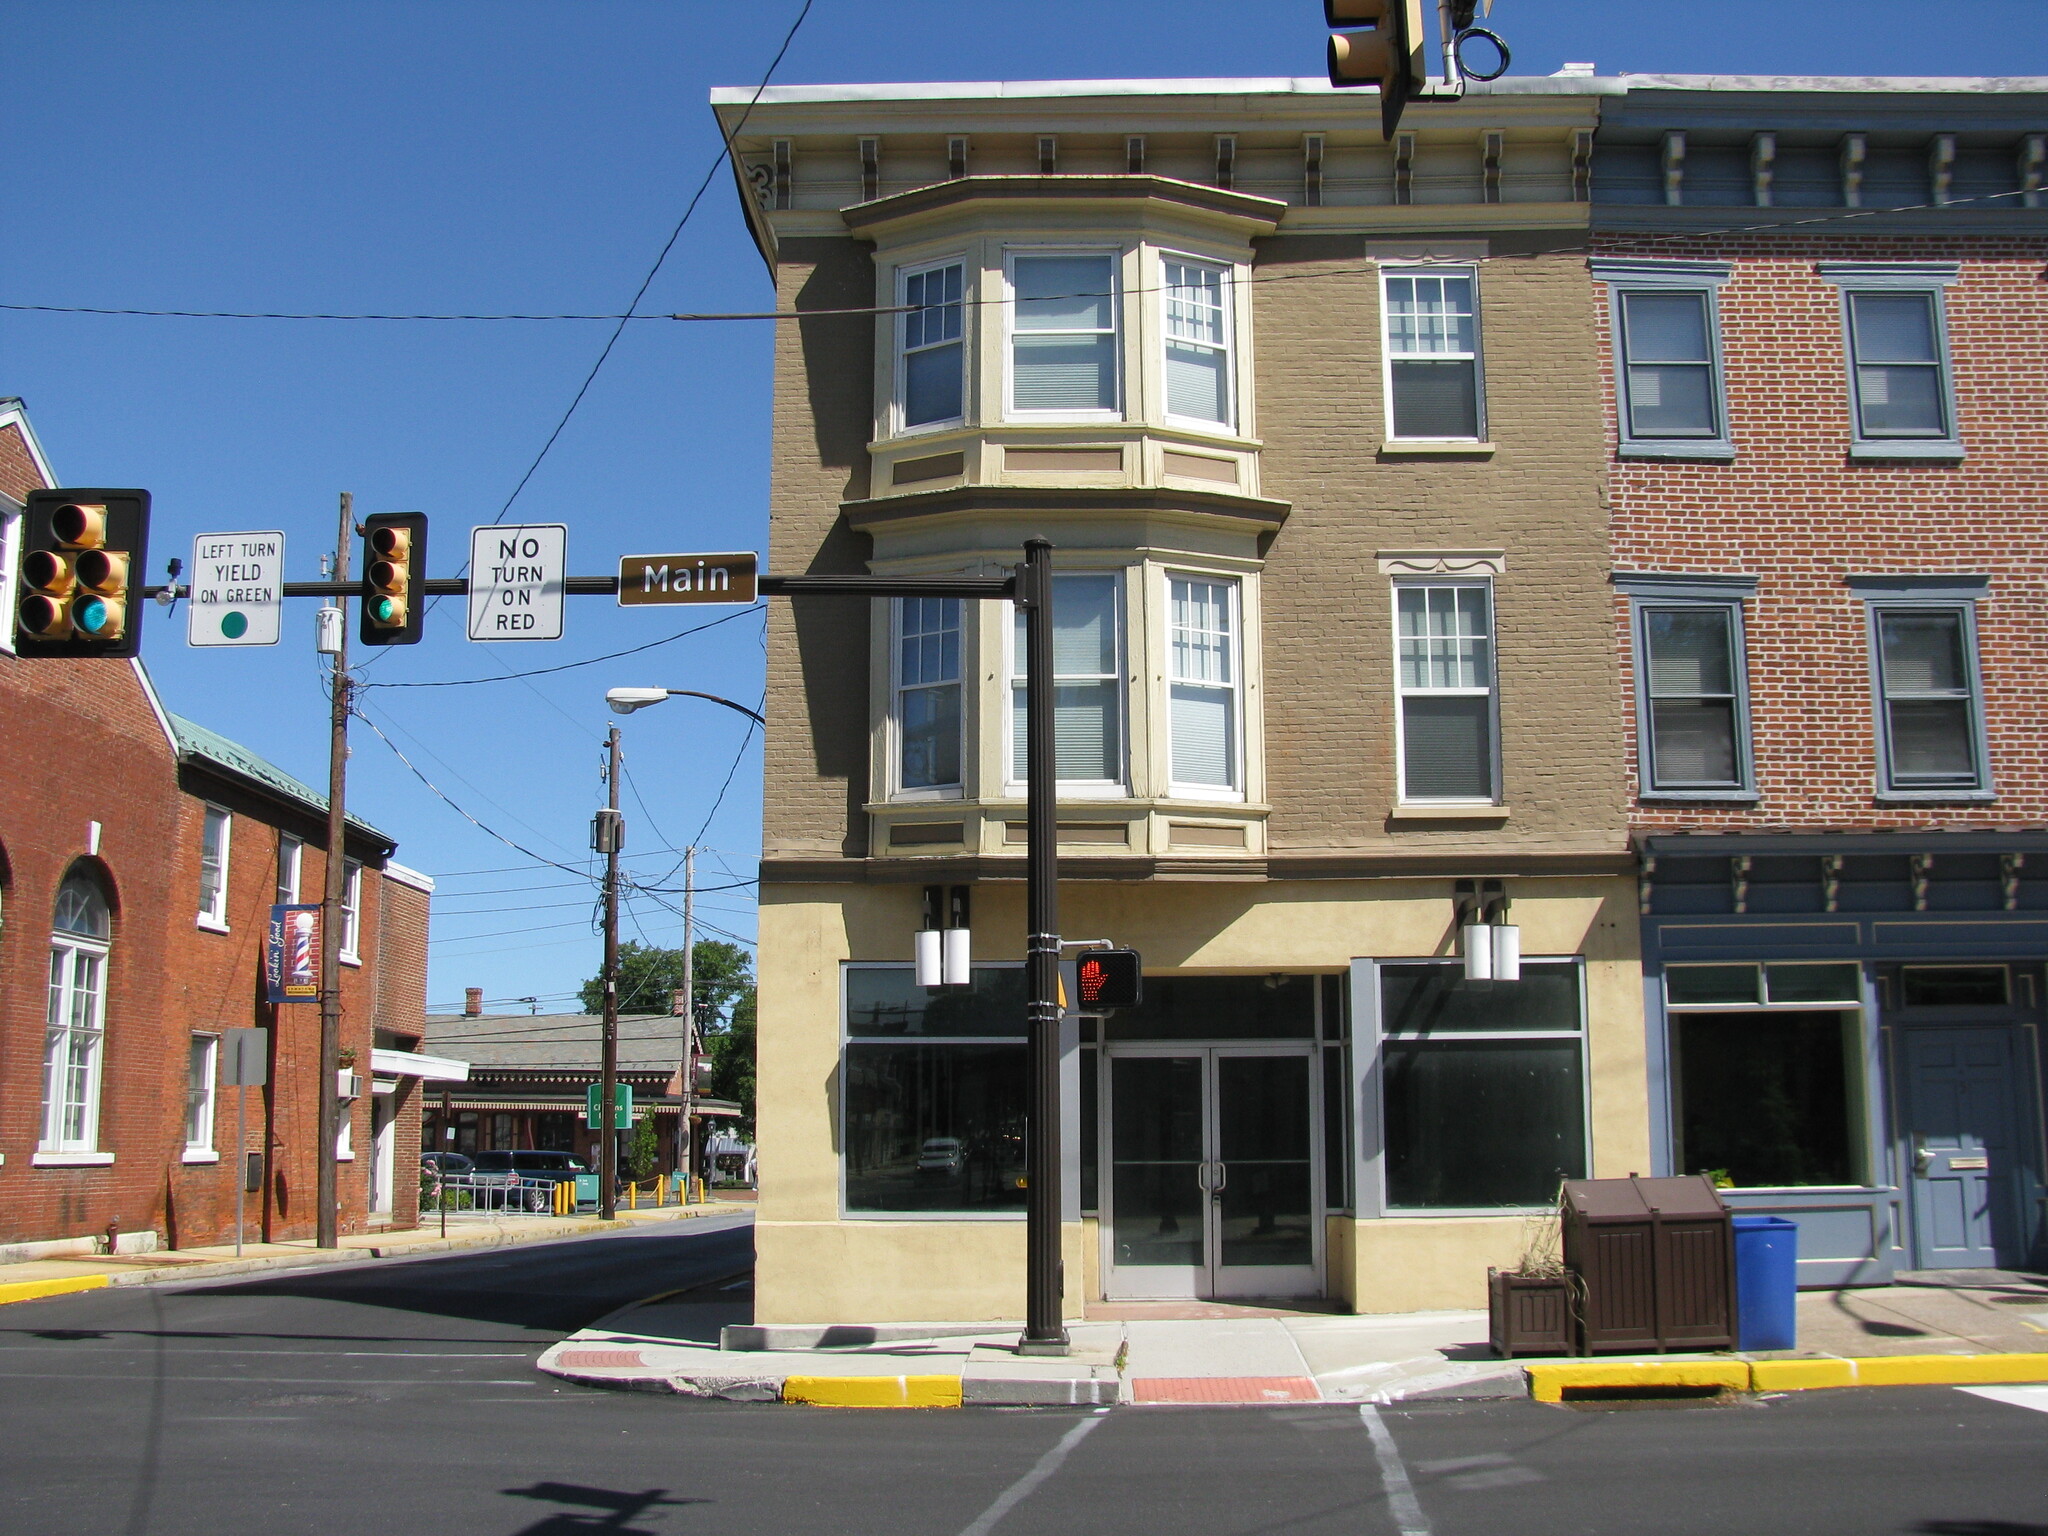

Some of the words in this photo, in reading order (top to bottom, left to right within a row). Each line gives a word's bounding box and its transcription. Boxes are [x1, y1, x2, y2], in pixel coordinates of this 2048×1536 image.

[202, 544, 234, 559] LEFT
[241, 543, 275, 557] TURN
[499, 538, 540, 559] NO
[215, 564, 261, 581] YIELD
[491, 566, 543, 583] TURN
[644, 560, 729, 593] Main
[201, 589, 218, 603] ON
[226, 588, 272, 602] GREEN
[502, 589, 530, 606] ON
[496, 613, 535, 630] RED
[269, 920, 285, 947] Good
